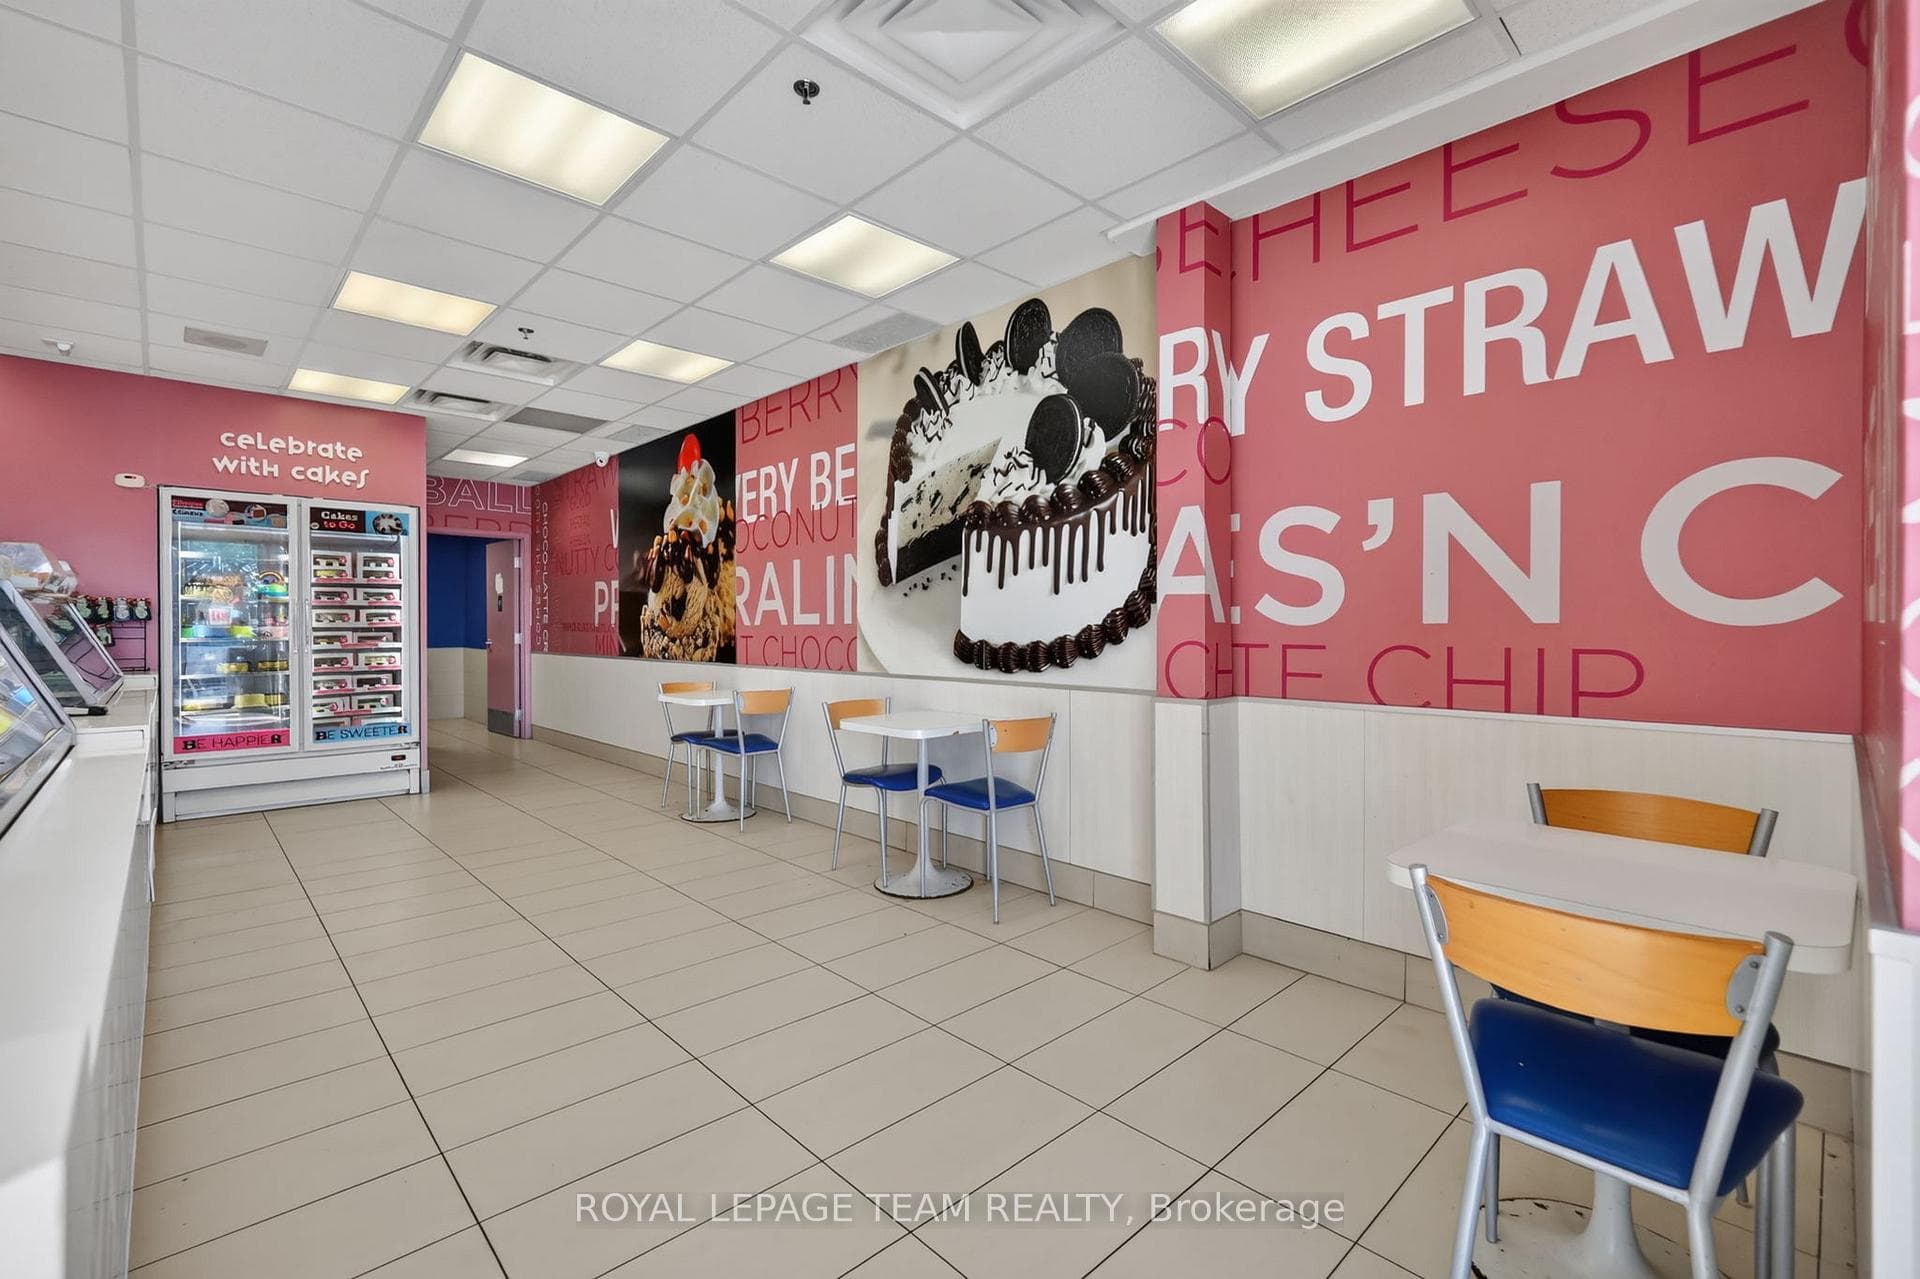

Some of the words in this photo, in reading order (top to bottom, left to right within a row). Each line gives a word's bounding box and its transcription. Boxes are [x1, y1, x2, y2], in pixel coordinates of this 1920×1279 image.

[1304, 177, 1867, 422] STRAW
[220, 431, 363, 462] celebrate
[212, 455, 279, 477] with
[290, 464, 370, 489] cakes
[321, 511, 359, 521] Cakes
[1639, 456, 1845, 627] C
[182, 739, 206, 751] BE
[211, 733, 282, 748] HAPPIER
[316, 730, 334, 741] BE
[340, 724, 408, 739] SWEETER
